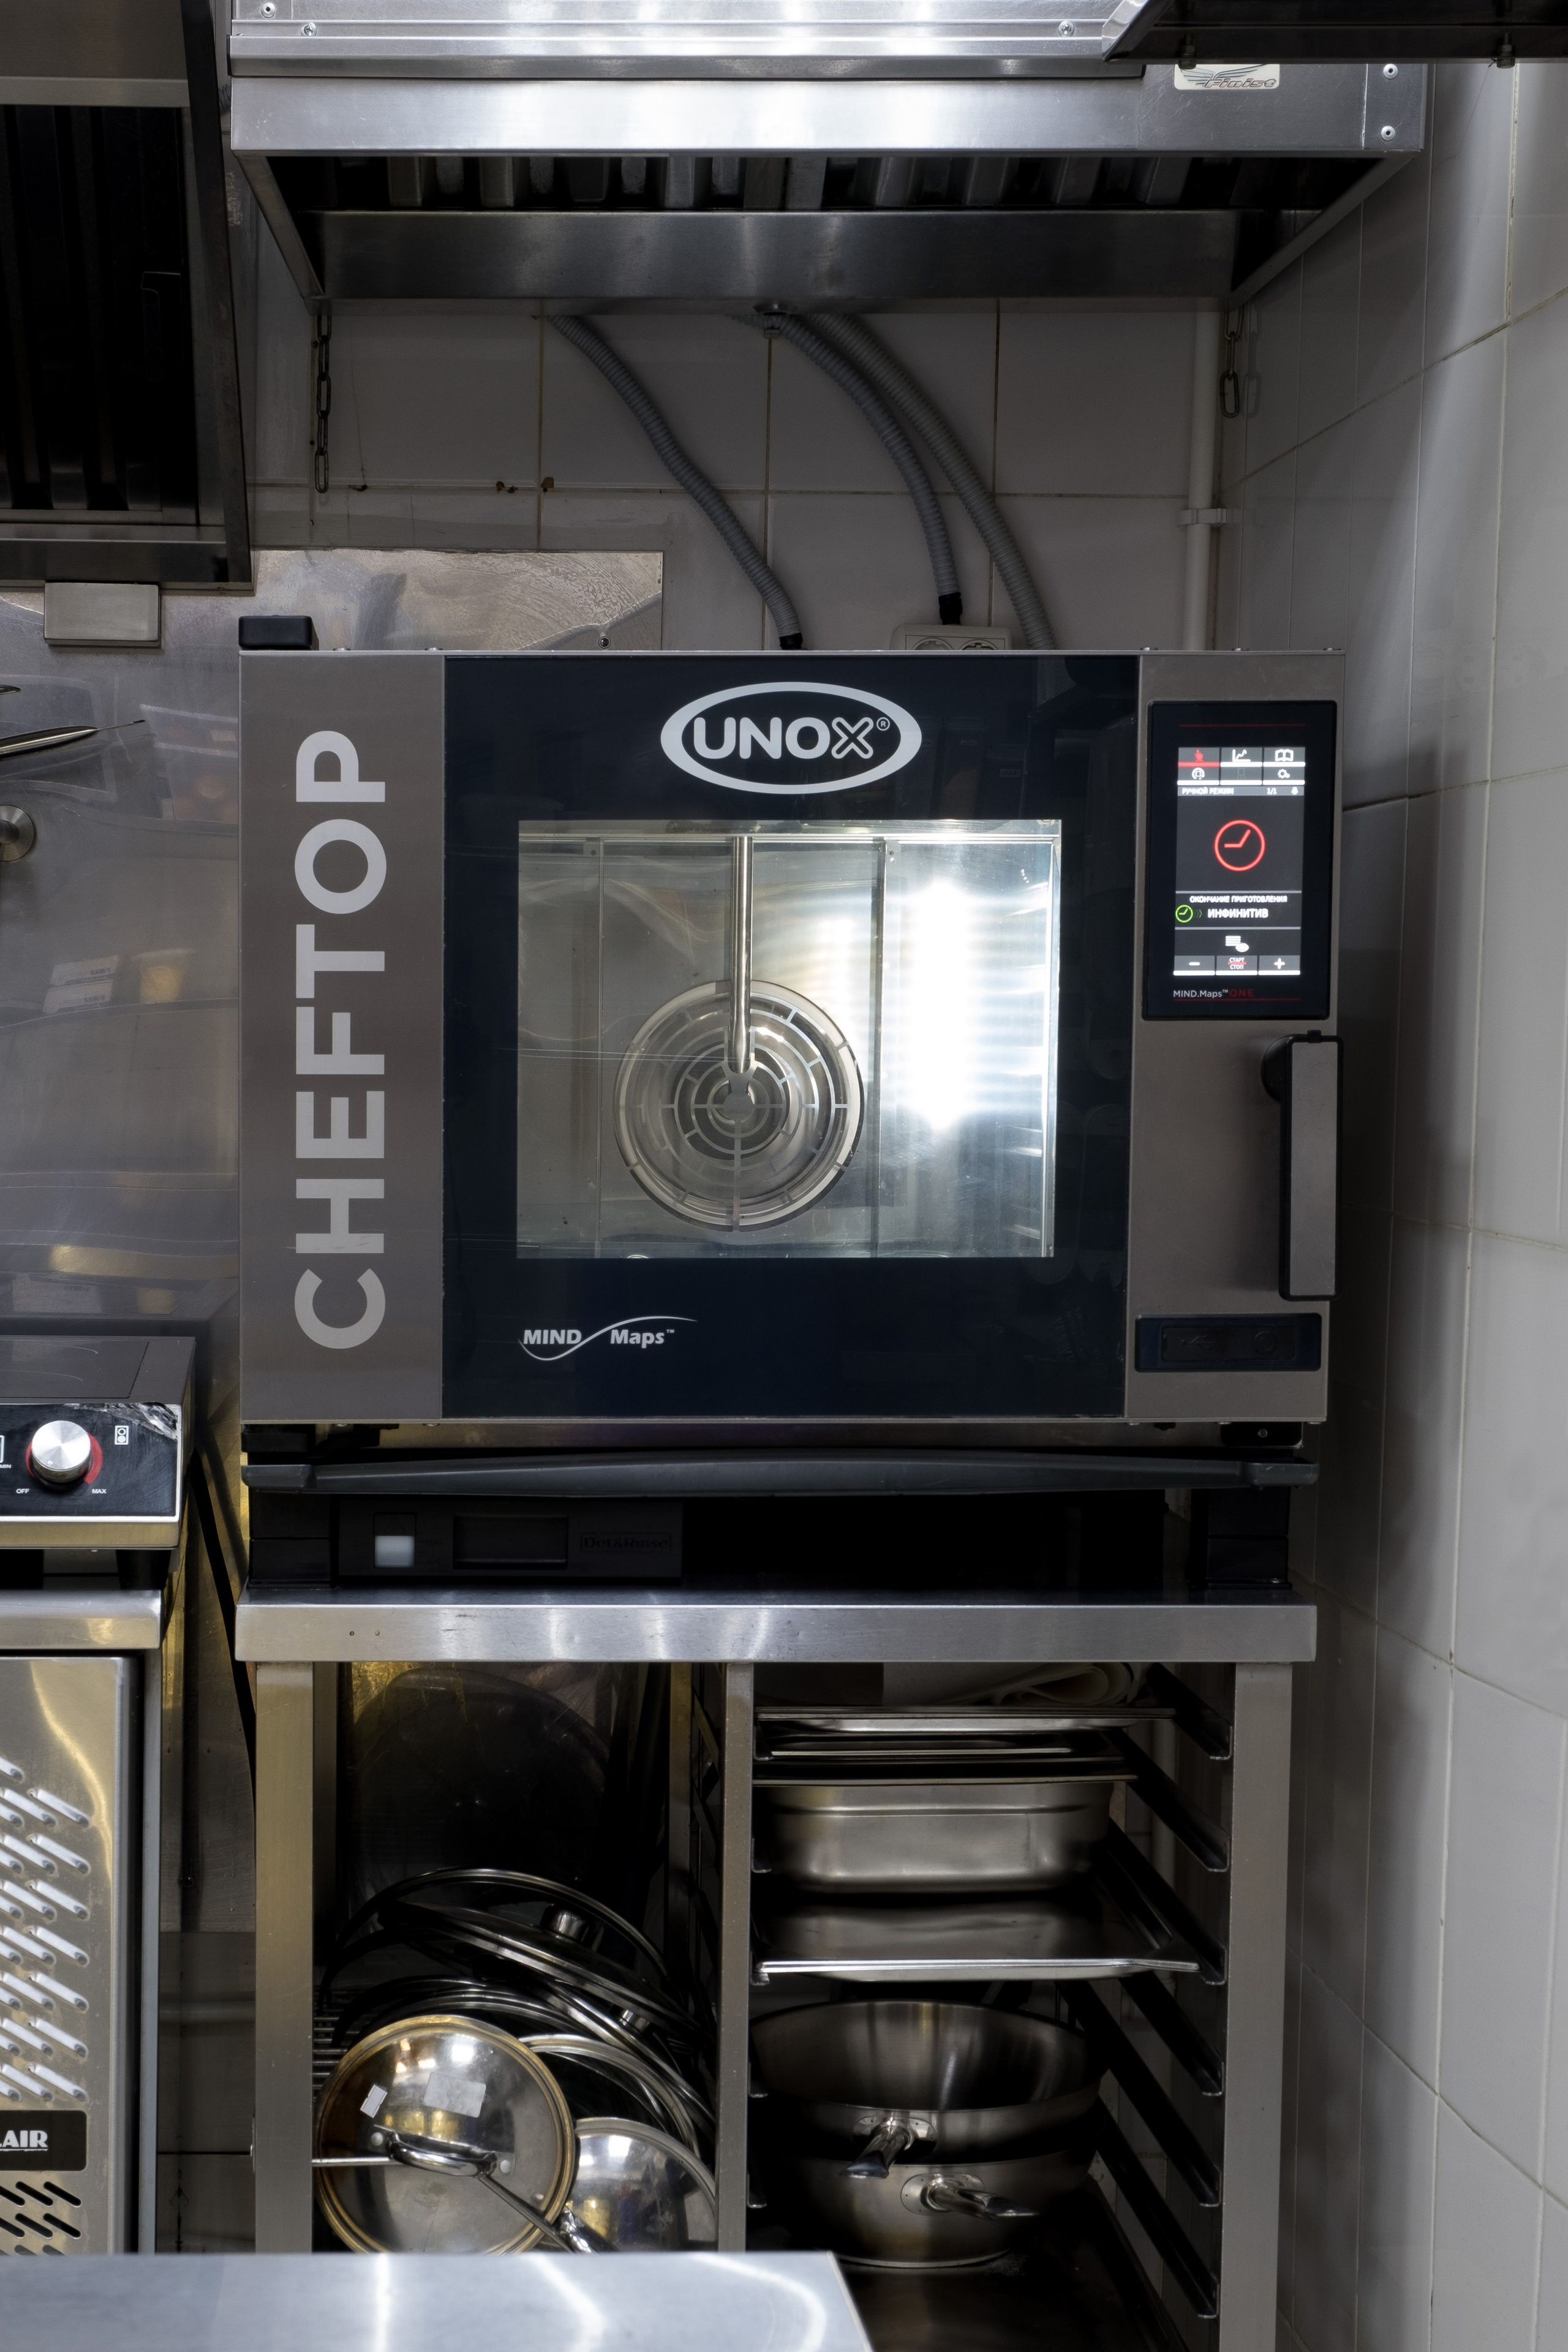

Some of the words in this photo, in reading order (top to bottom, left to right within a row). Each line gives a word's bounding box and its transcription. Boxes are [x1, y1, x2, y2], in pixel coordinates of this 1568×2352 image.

[1204, 78, 1276, 88] Finist
[1189, 895, 1230, 903] ОКОНЧАНИЕ
[1207, 908, 1268, 918] ИНФИНИТИВ
[1229, 989, 1254, 997] ONE
[294, 730, 387, 1349] CHEFTOP
[523, 1329, 582, 1344] MIND
[0, 2130, 48, 2147] AIR
